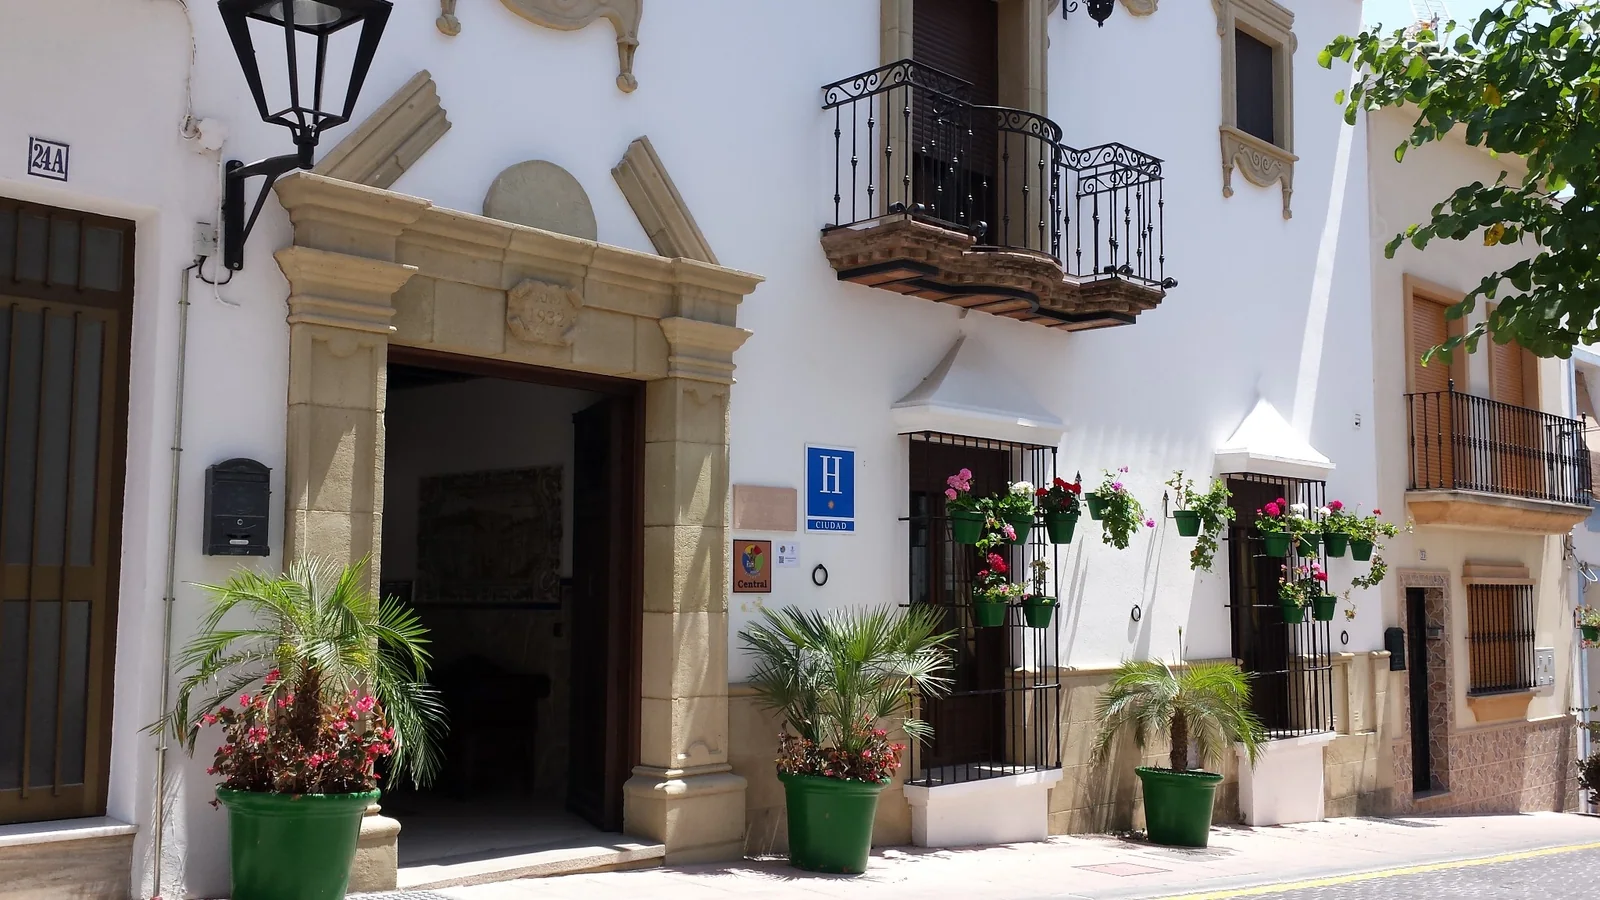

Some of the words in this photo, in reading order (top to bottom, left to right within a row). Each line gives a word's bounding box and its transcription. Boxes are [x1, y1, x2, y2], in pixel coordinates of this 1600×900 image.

[32, 143, 65, 174] 24A
[528, 308, 565, 328] 1932
[820, 455, 843, 494] H
[815, 520, 847, 530] CIUDAD
[737, 579, 768, 589] Central
